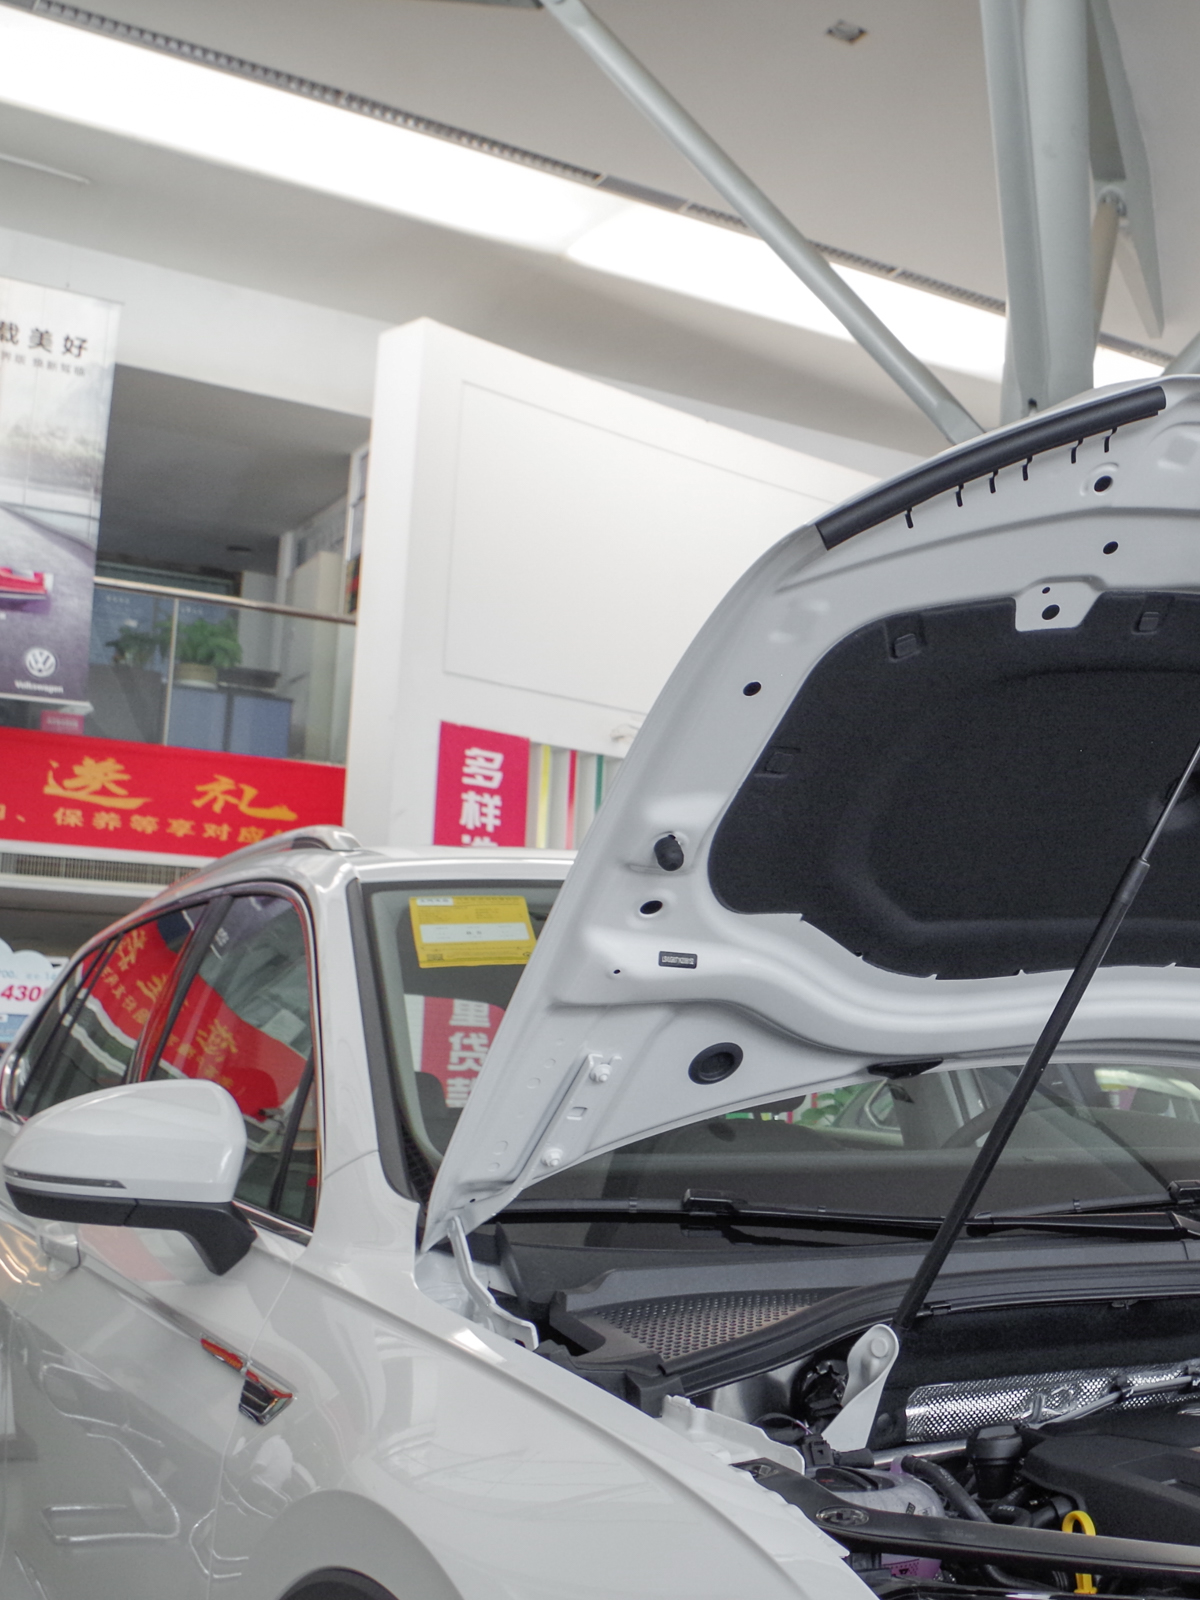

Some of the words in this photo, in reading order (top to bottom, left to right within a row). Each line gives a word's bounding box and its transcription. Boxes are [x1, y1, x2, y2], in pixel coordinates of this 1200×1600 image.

[14, 679, 64, 695] Volkswagen
[43, 755, 299, 822] 送礼
[0, 985, 48, 1002] 430
